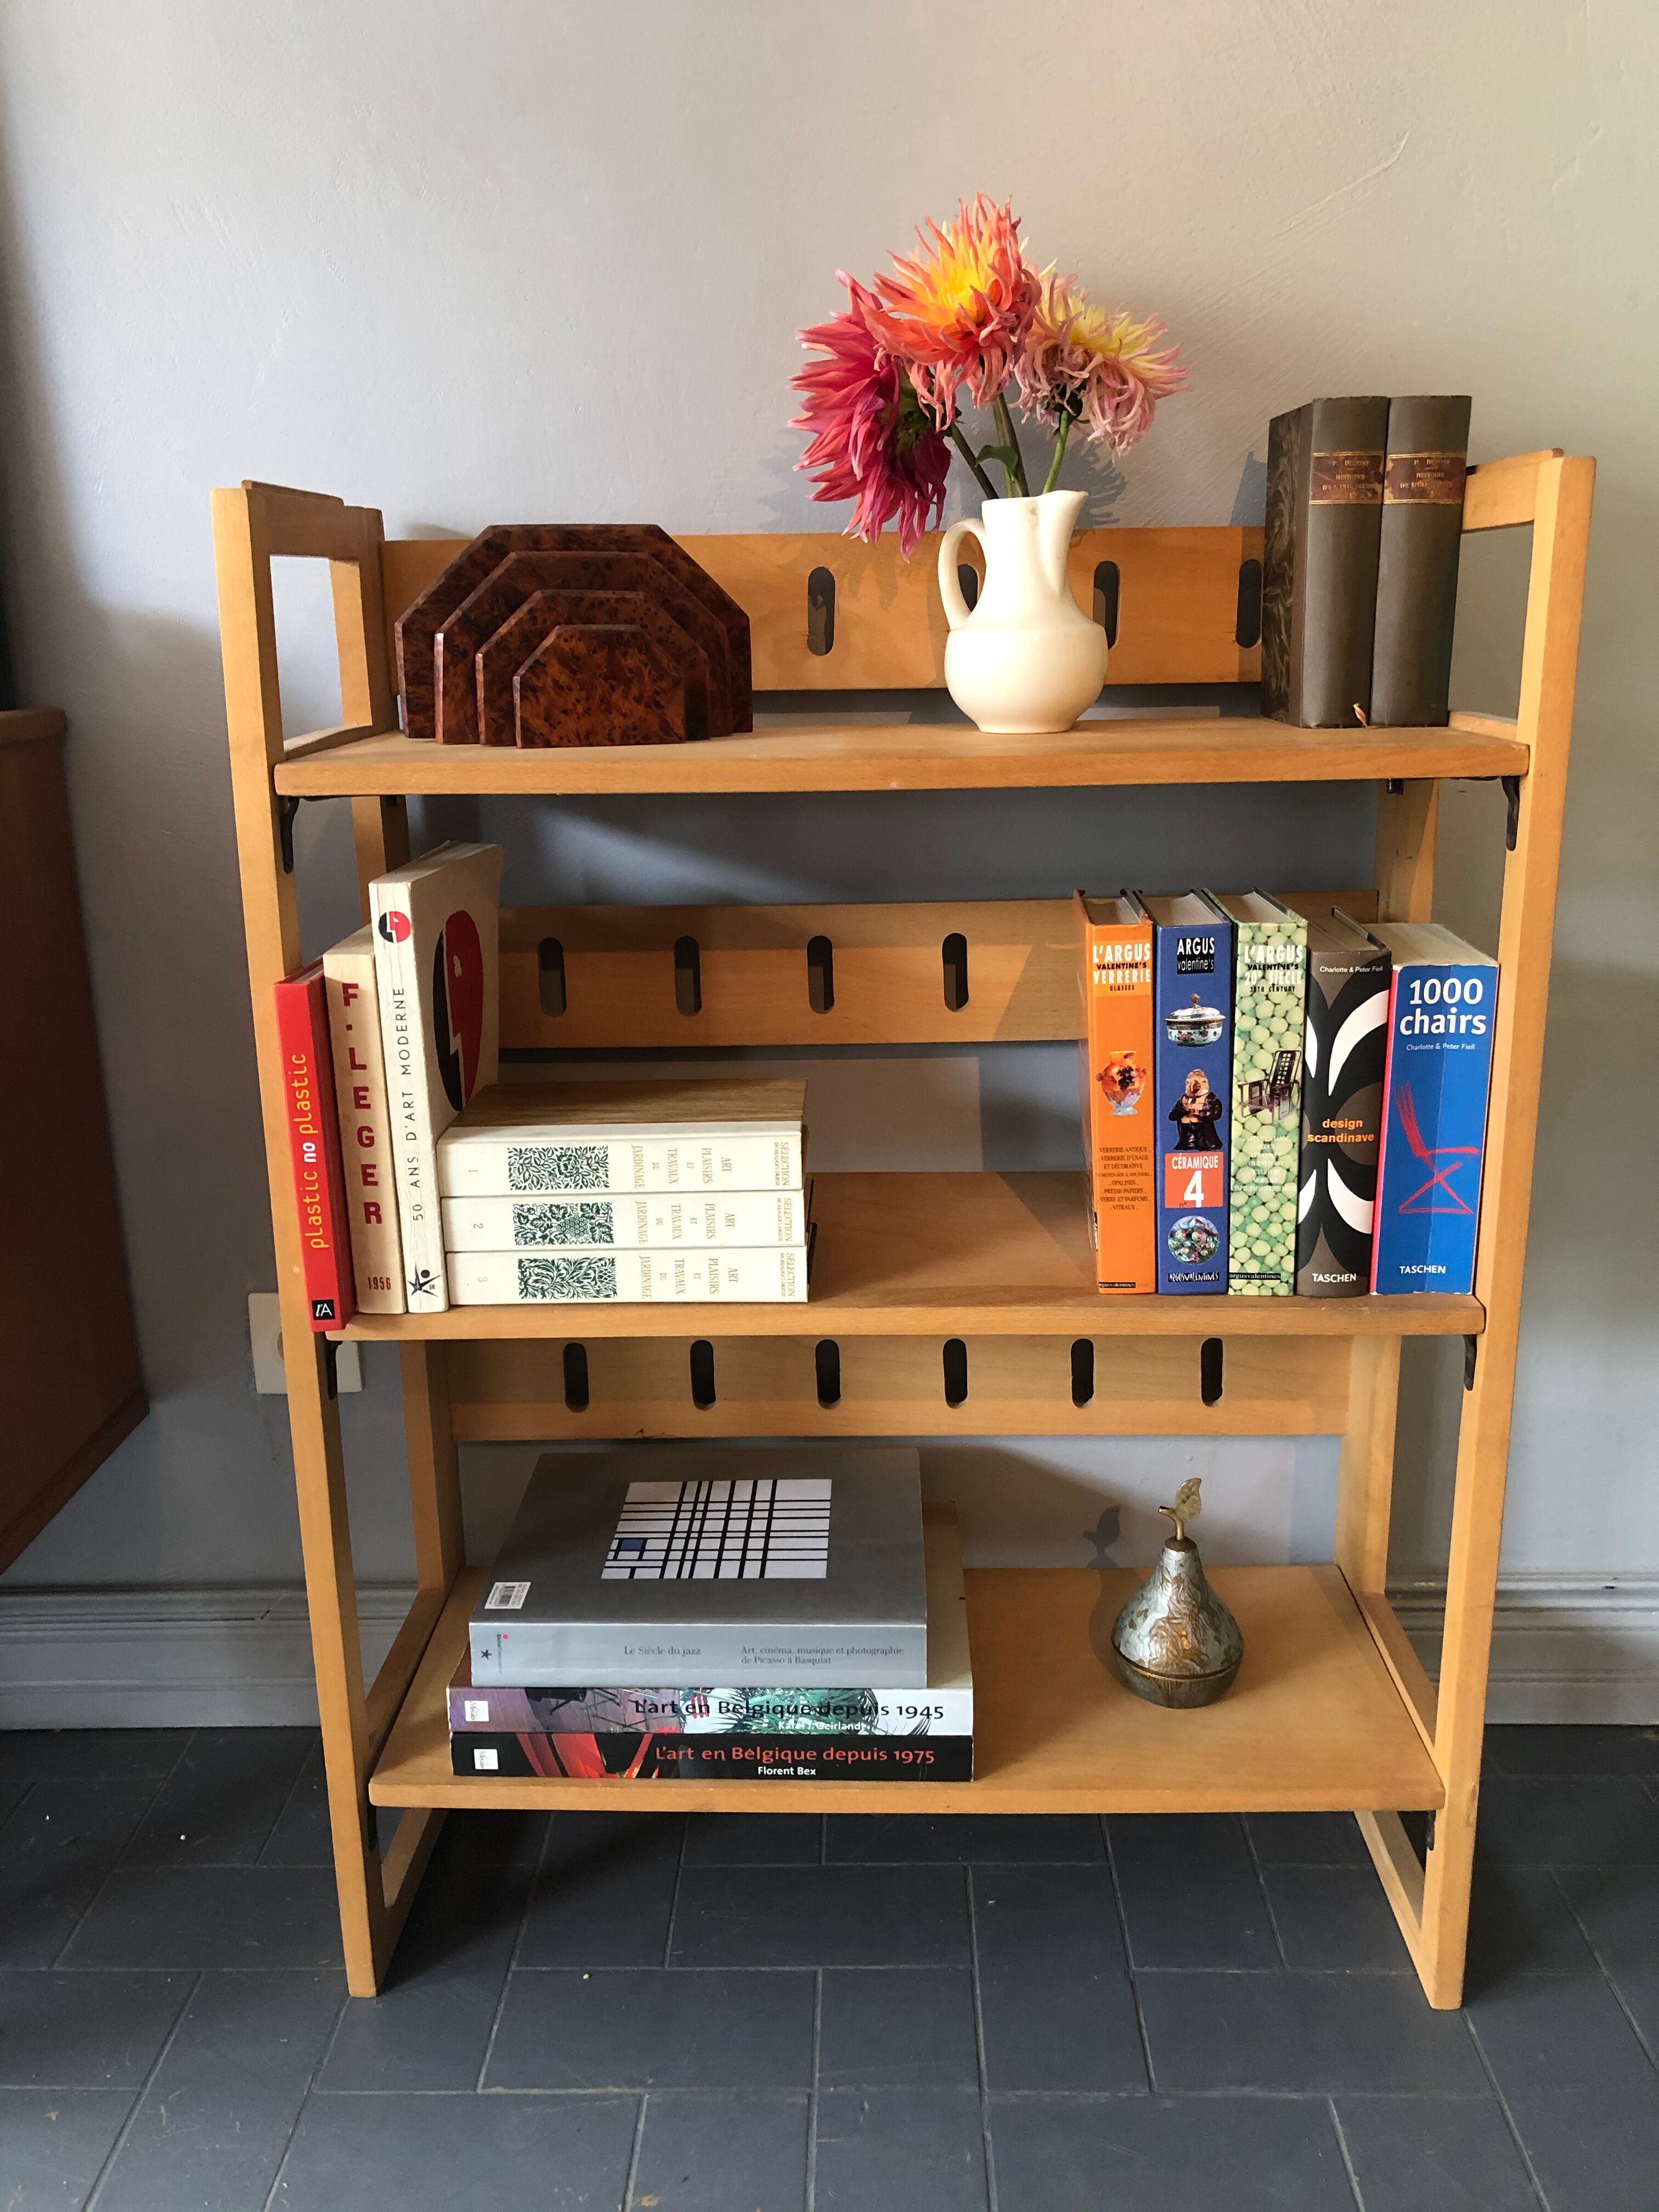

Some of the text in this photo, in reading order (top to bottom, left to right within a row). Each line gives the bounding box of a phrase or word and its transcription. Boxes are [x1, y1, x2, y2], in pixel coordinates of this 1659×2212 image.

[1092, 943, 1150, 963] L'ARGUS
[1177, 936, 1215, 956] ARGUS
[1244, 944, 1303, 963] L'ARGUS
[1097, 962, 1147, 970] VALENTINE'S
[1177, 956, 1214, 971] valentine's
[1093, 969, 1150, 985] VERRERIE
[1409, 978, 1483, 1005] 1000
[1400, 1007, 1487, 1036] chairs
[393, 988, 424, 1222] 50 ANS D'ART MODERNE
[1322, 1118, 1363, 1130] design
[1307, 1132, 1375, 1143] scandinave
[288, 1053, 330, 1249] plastic no plastic
[631, 1144, 645, 1190] JARDINAGE
[667, 1147, 679, 1185] TRAVAUX
[686, 1161, 694, 1170] ET
[701, 1147, 714, 1184] PLAISIRS
[721, 1157, 732, 1173] ART
[1171, 1152, 1219, 1170] CÉRAMIQUE
[1183, 1170, 1205, 1208] 4
[635, 1200, 649, 1245] JARDINAGE
[671, 1204, 683, 1240] TRAVAUX
[705, 1203, 716, 1240] PLAISIRS
[725, 1212, 735, 1228] ART
[639, 1255, 652, 1300] JARDINAGE
[674, 1258, 686, 1295] TRAVAUX
[708, 1258, 720, 1295] PLAISIRS
[727, 1267, 738, 1284] ART
[1312, 1273, 1357, 1283] TASCHEN
[1399, 1265, 1446, 1274] TASCHEN
[367, 1276, 392, 1291] 1956
[624, 1645, 702, 1657] Le Siècle du jazz
[797, 1647, 834, 1657] musique
[836, 1646, 845, 1655] et
[847, 1646, 904, 1657] photographie
[741, 1655, 832, 1666] de Picasso à Basquiat
[635, 1699, 944, 1719] L'art en Belgique depuis 1945
[656, 1746, 694, 1760] L'art
[702, 1749, 725, 1760] en
[822, 1746, 888, 1764] depuis
[893, 1750, 935, 1764] 1975
[758, 1766, 817, 1776] Florent Bex
